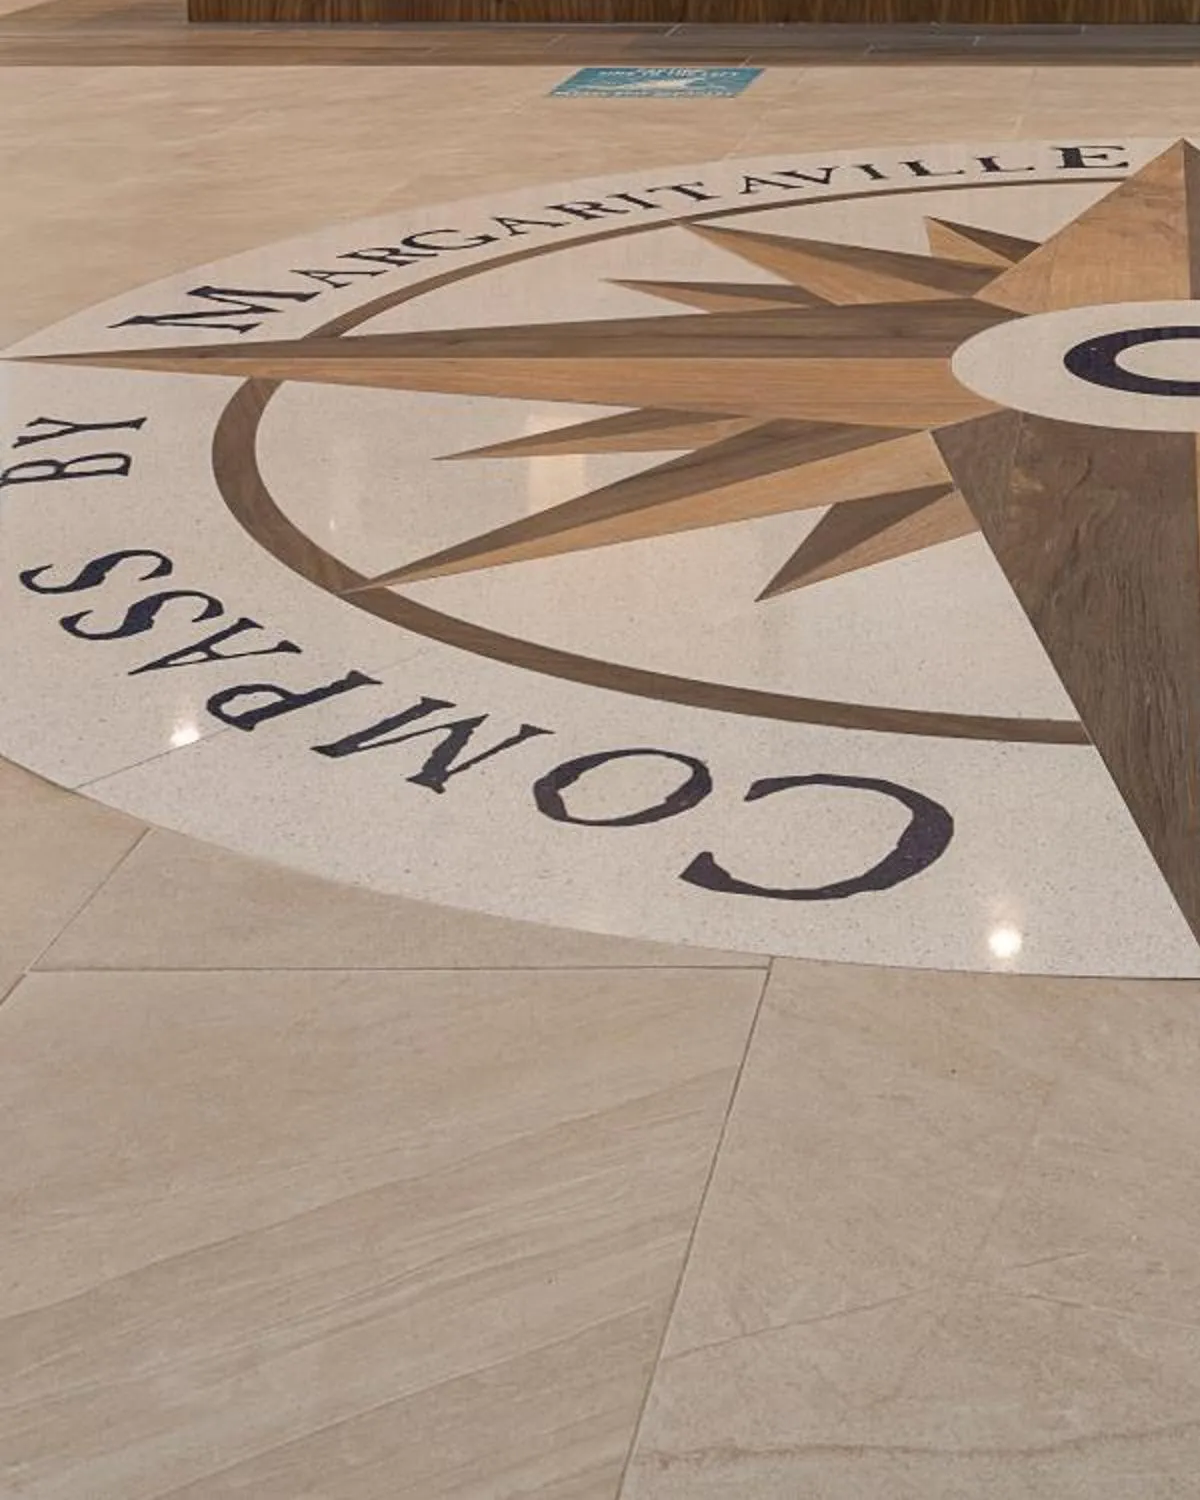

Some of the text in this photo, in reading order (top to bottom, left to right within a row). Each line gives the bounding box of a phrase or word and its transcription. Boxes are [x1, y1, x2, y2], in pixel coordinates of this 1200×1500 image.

[0, 145, 1129, 900] COMPASS BY MARGARITAVILLE
